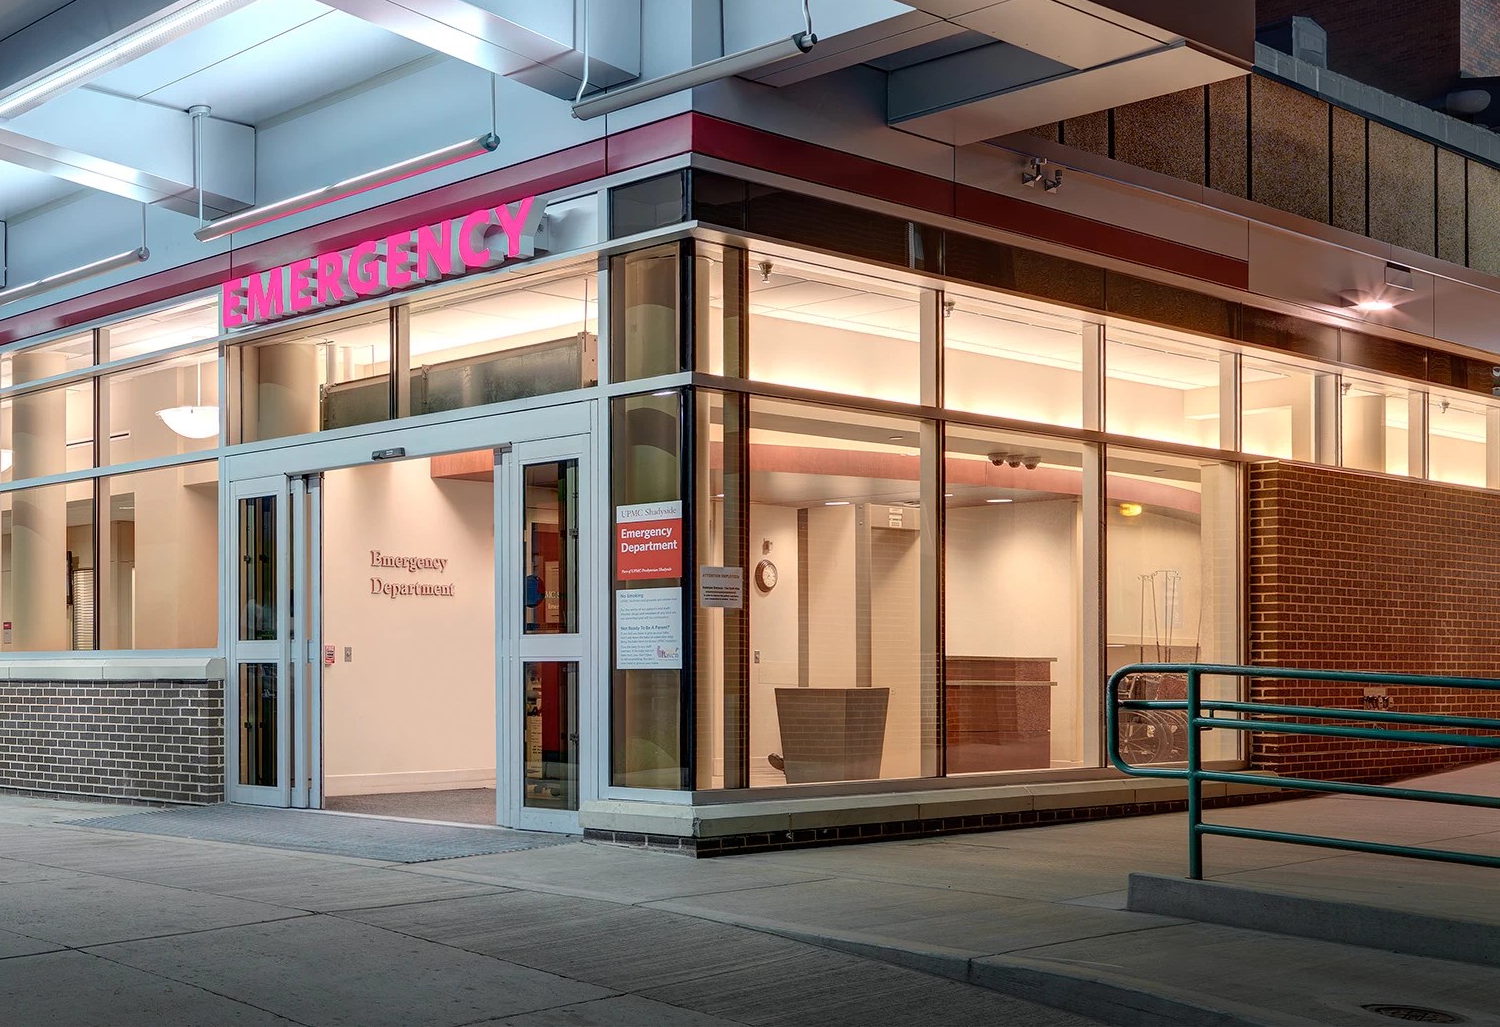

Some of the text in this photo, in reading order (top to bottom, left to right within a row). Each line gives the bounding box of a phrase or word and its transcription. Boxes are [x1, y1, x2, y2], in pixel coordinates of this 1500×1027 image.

[222, 196, 536, 328] EMERGENCY
[621, 506, 677, 518] UPMC Shadyside
[621, 527, 673, 539] Emergency
[621, 540, 678, 554] Department
[370, 550, 448, 573] Emergency
[370, 577, 456, 599] Department
